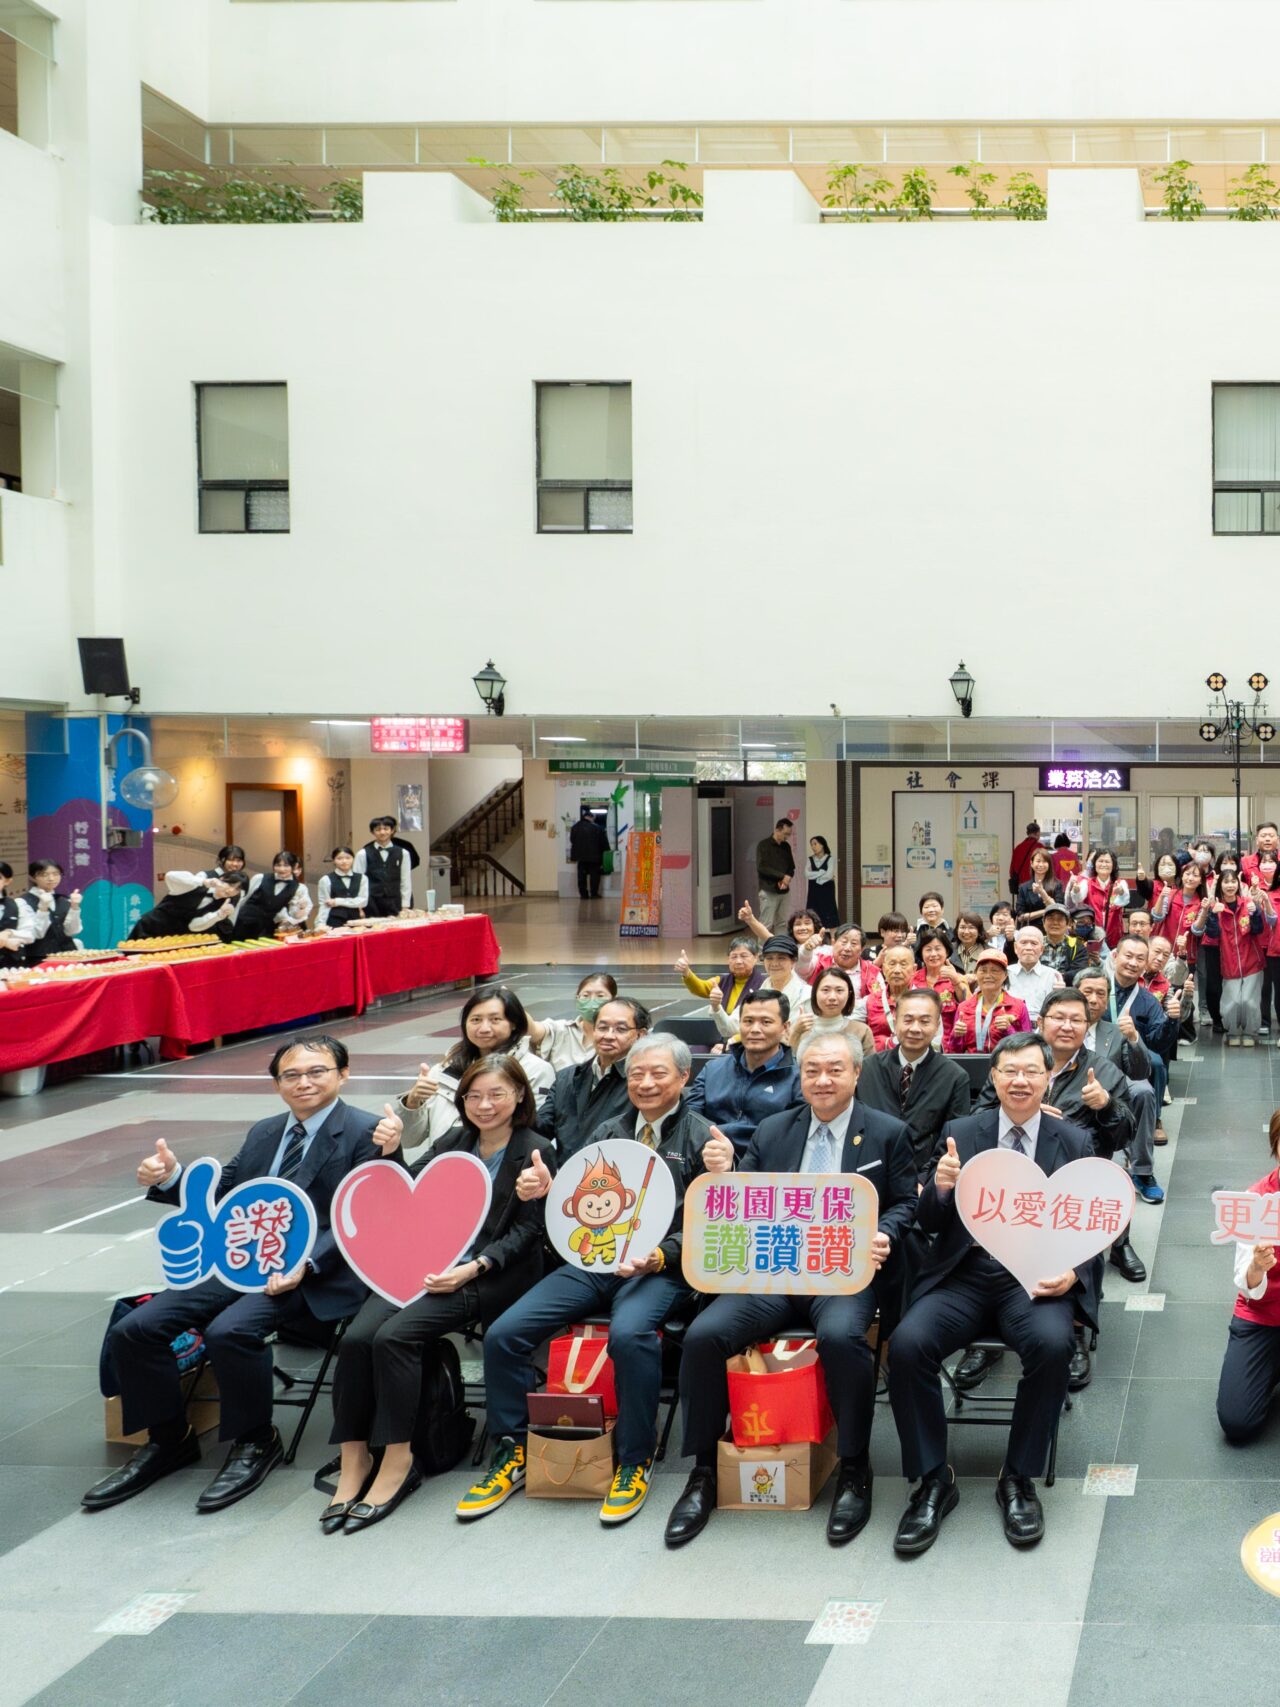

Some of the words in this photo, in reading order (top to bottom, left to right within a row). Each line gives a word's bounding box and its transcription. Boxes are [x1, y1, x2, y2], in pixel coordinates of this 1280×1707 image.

[906, 770, 1000, 789] 社會課
[1047, 769, 1122, 789] 業務洽公
[963, 800, 978, 829] 入口
[704, 1185, 854, 1221] 桃園更保
[971, 1186, 1124, 1234] 以愛復歸
[228, 1200, 291, 1271] 讚
[703, 1224, 854, 1274] 讚讚讚
